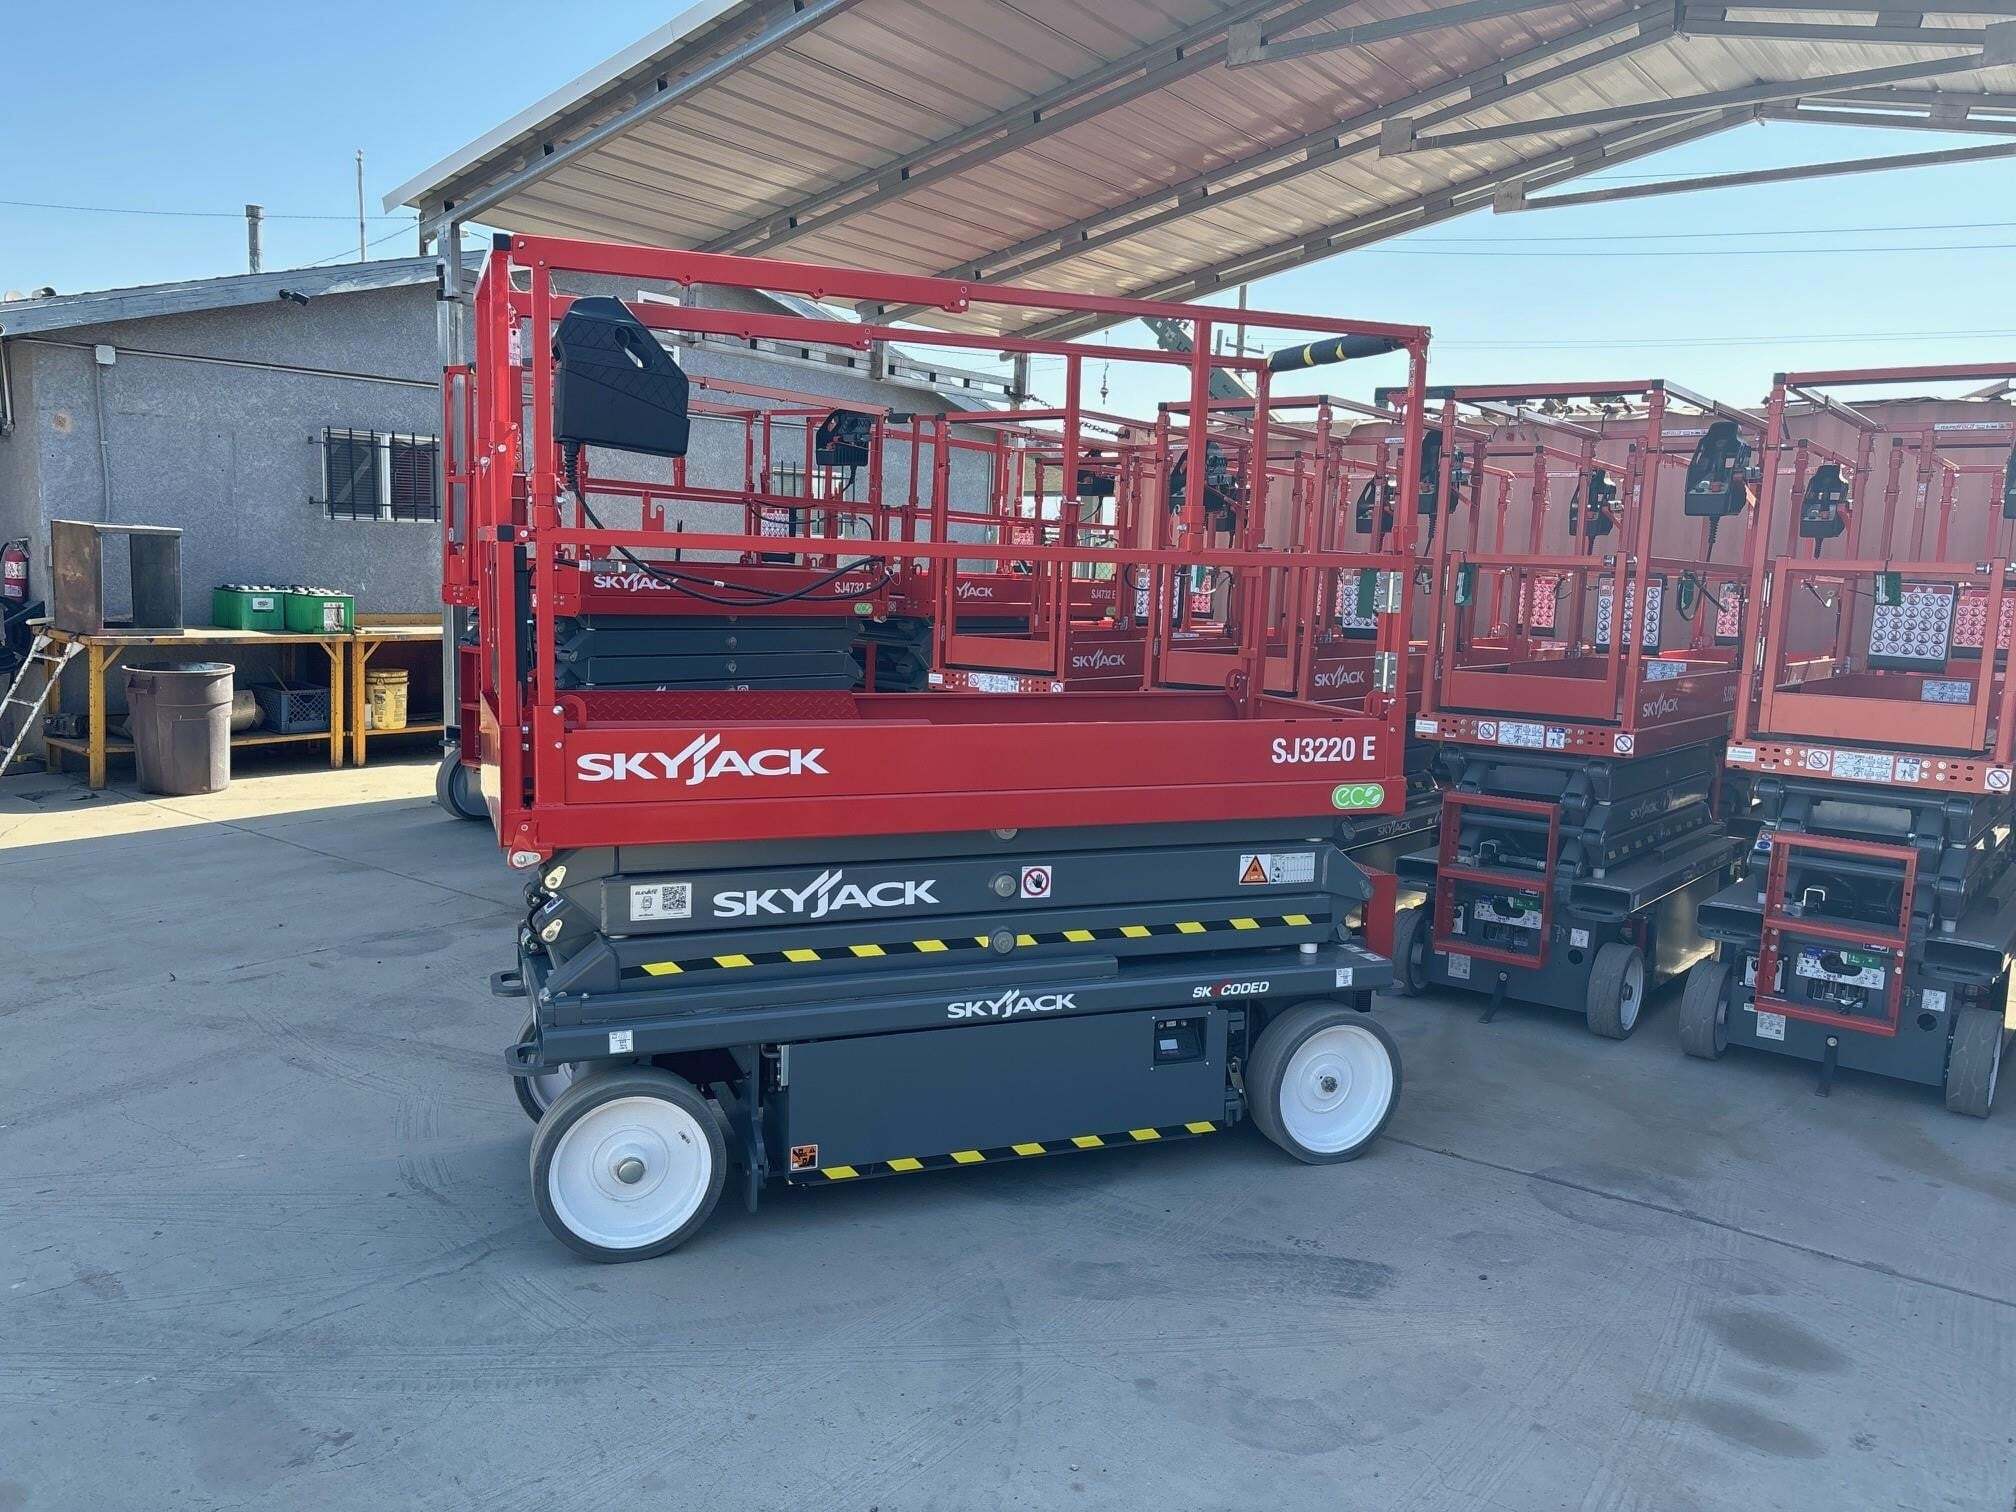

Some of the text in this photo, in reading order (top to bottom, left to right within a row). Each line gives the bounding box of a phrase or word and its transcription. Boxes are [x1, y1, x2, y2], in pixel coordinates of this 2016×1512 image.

[1072, 648, 1126, 669] SKYJACK
[1314, 665, 1365, 688] SKYJACK
[1642, 693, 1679, 719] SKYJACK
[577, 733, 829, 785] SKYJACK
[1271, 735, 1376, 764] SJ3220 E
[1335, 785, 1381, 807] eco
[713, 869, 940, 918] SKYJACK
[947, 989, 1076, 1018] SKYJACK
